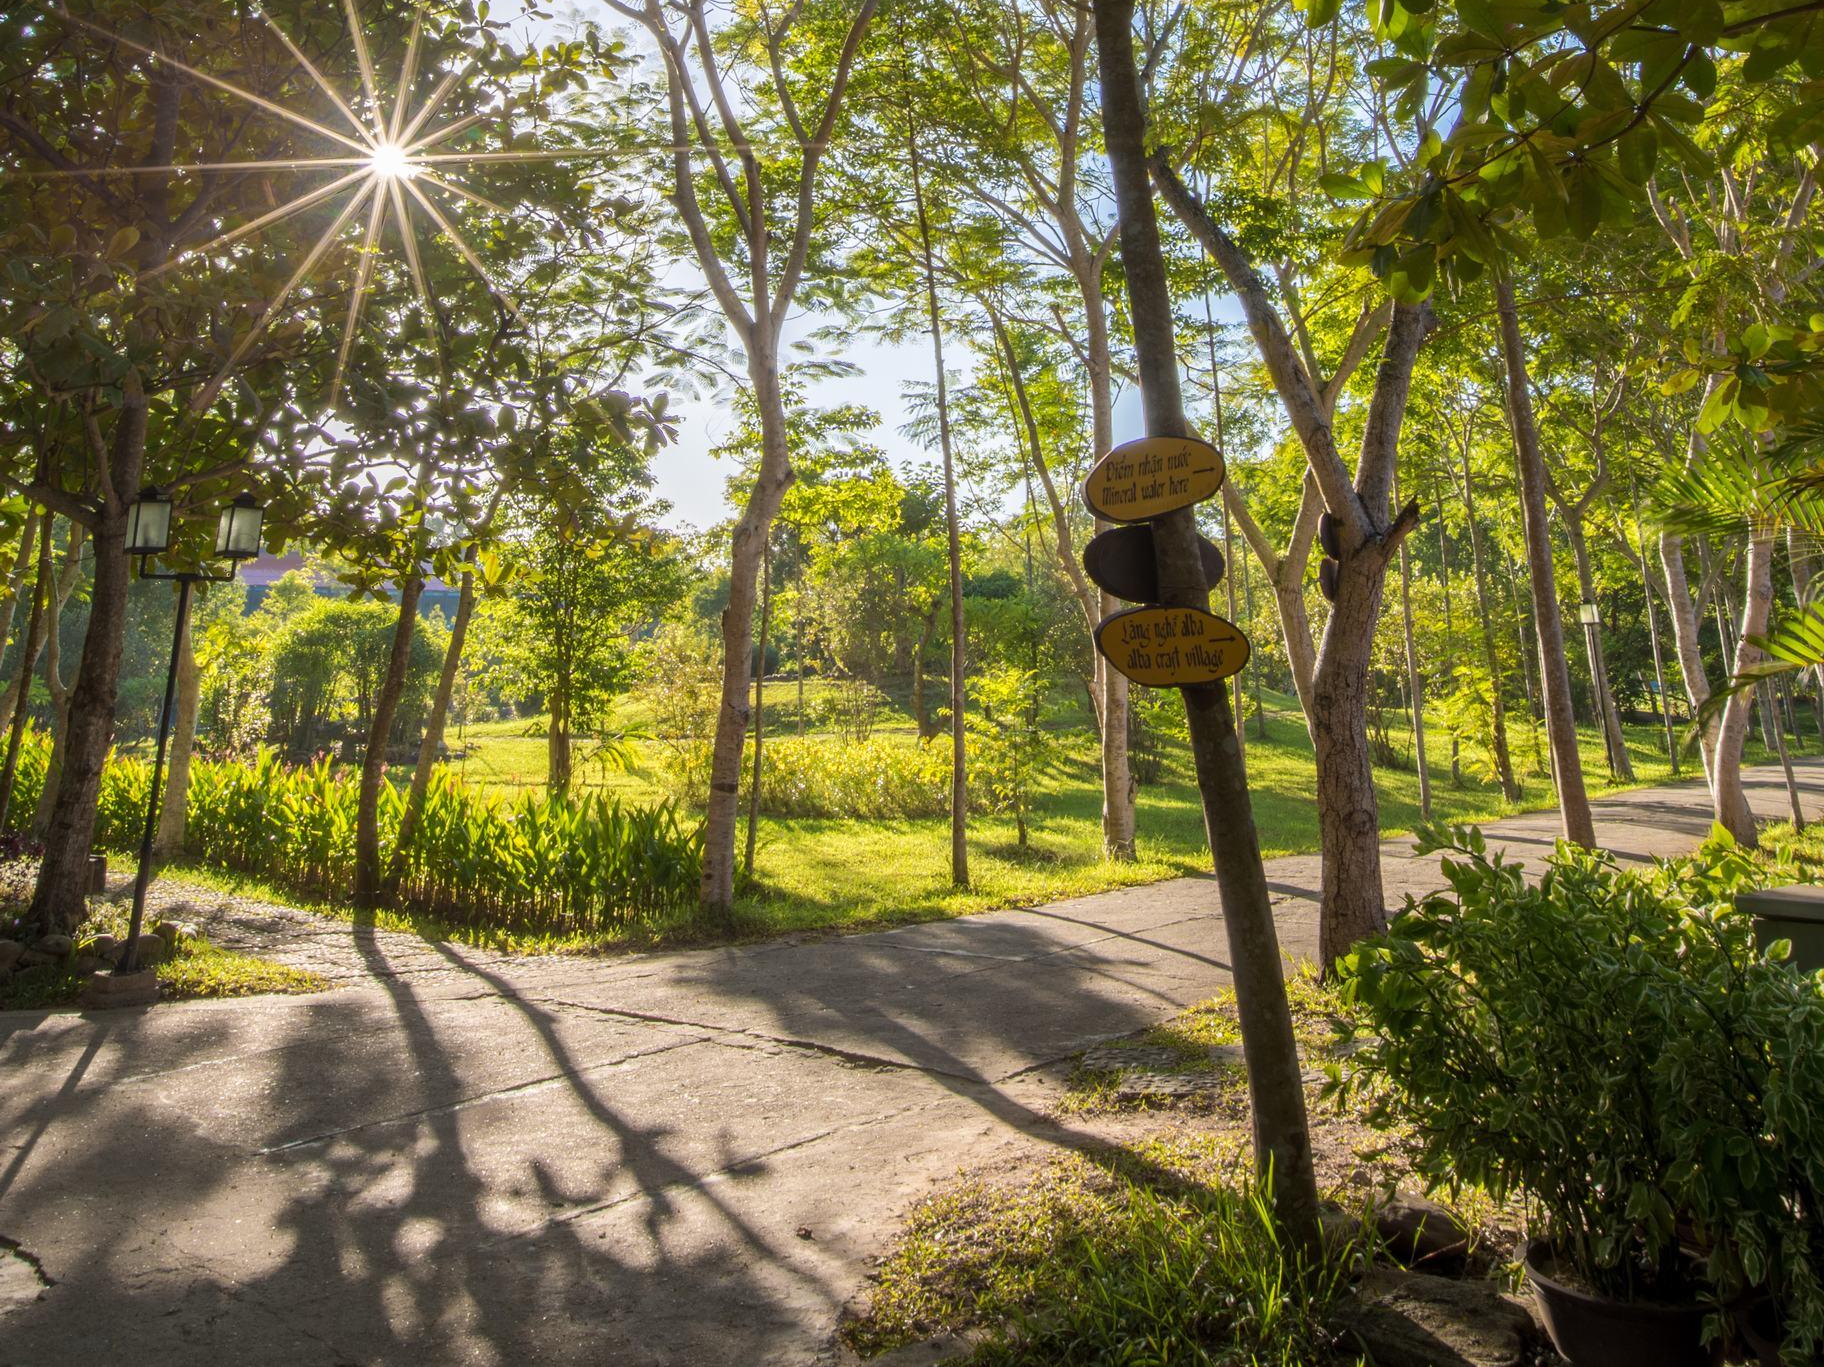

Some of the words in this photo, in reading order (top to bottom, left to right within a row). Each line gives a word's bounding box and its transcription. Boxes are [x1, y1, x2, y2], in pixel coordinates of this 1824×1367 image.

[1139, 455, 1163, 478] nhận
[1103, 482, 1136, 505] Mineral
[1141, 480, 1165, 501] water
[1169, 476, 1190, 497] here
[1127, 648, 1152, 669] alba
[1155, 646, 1180, 673] craft
[1186, 644, 1224, 673] village
